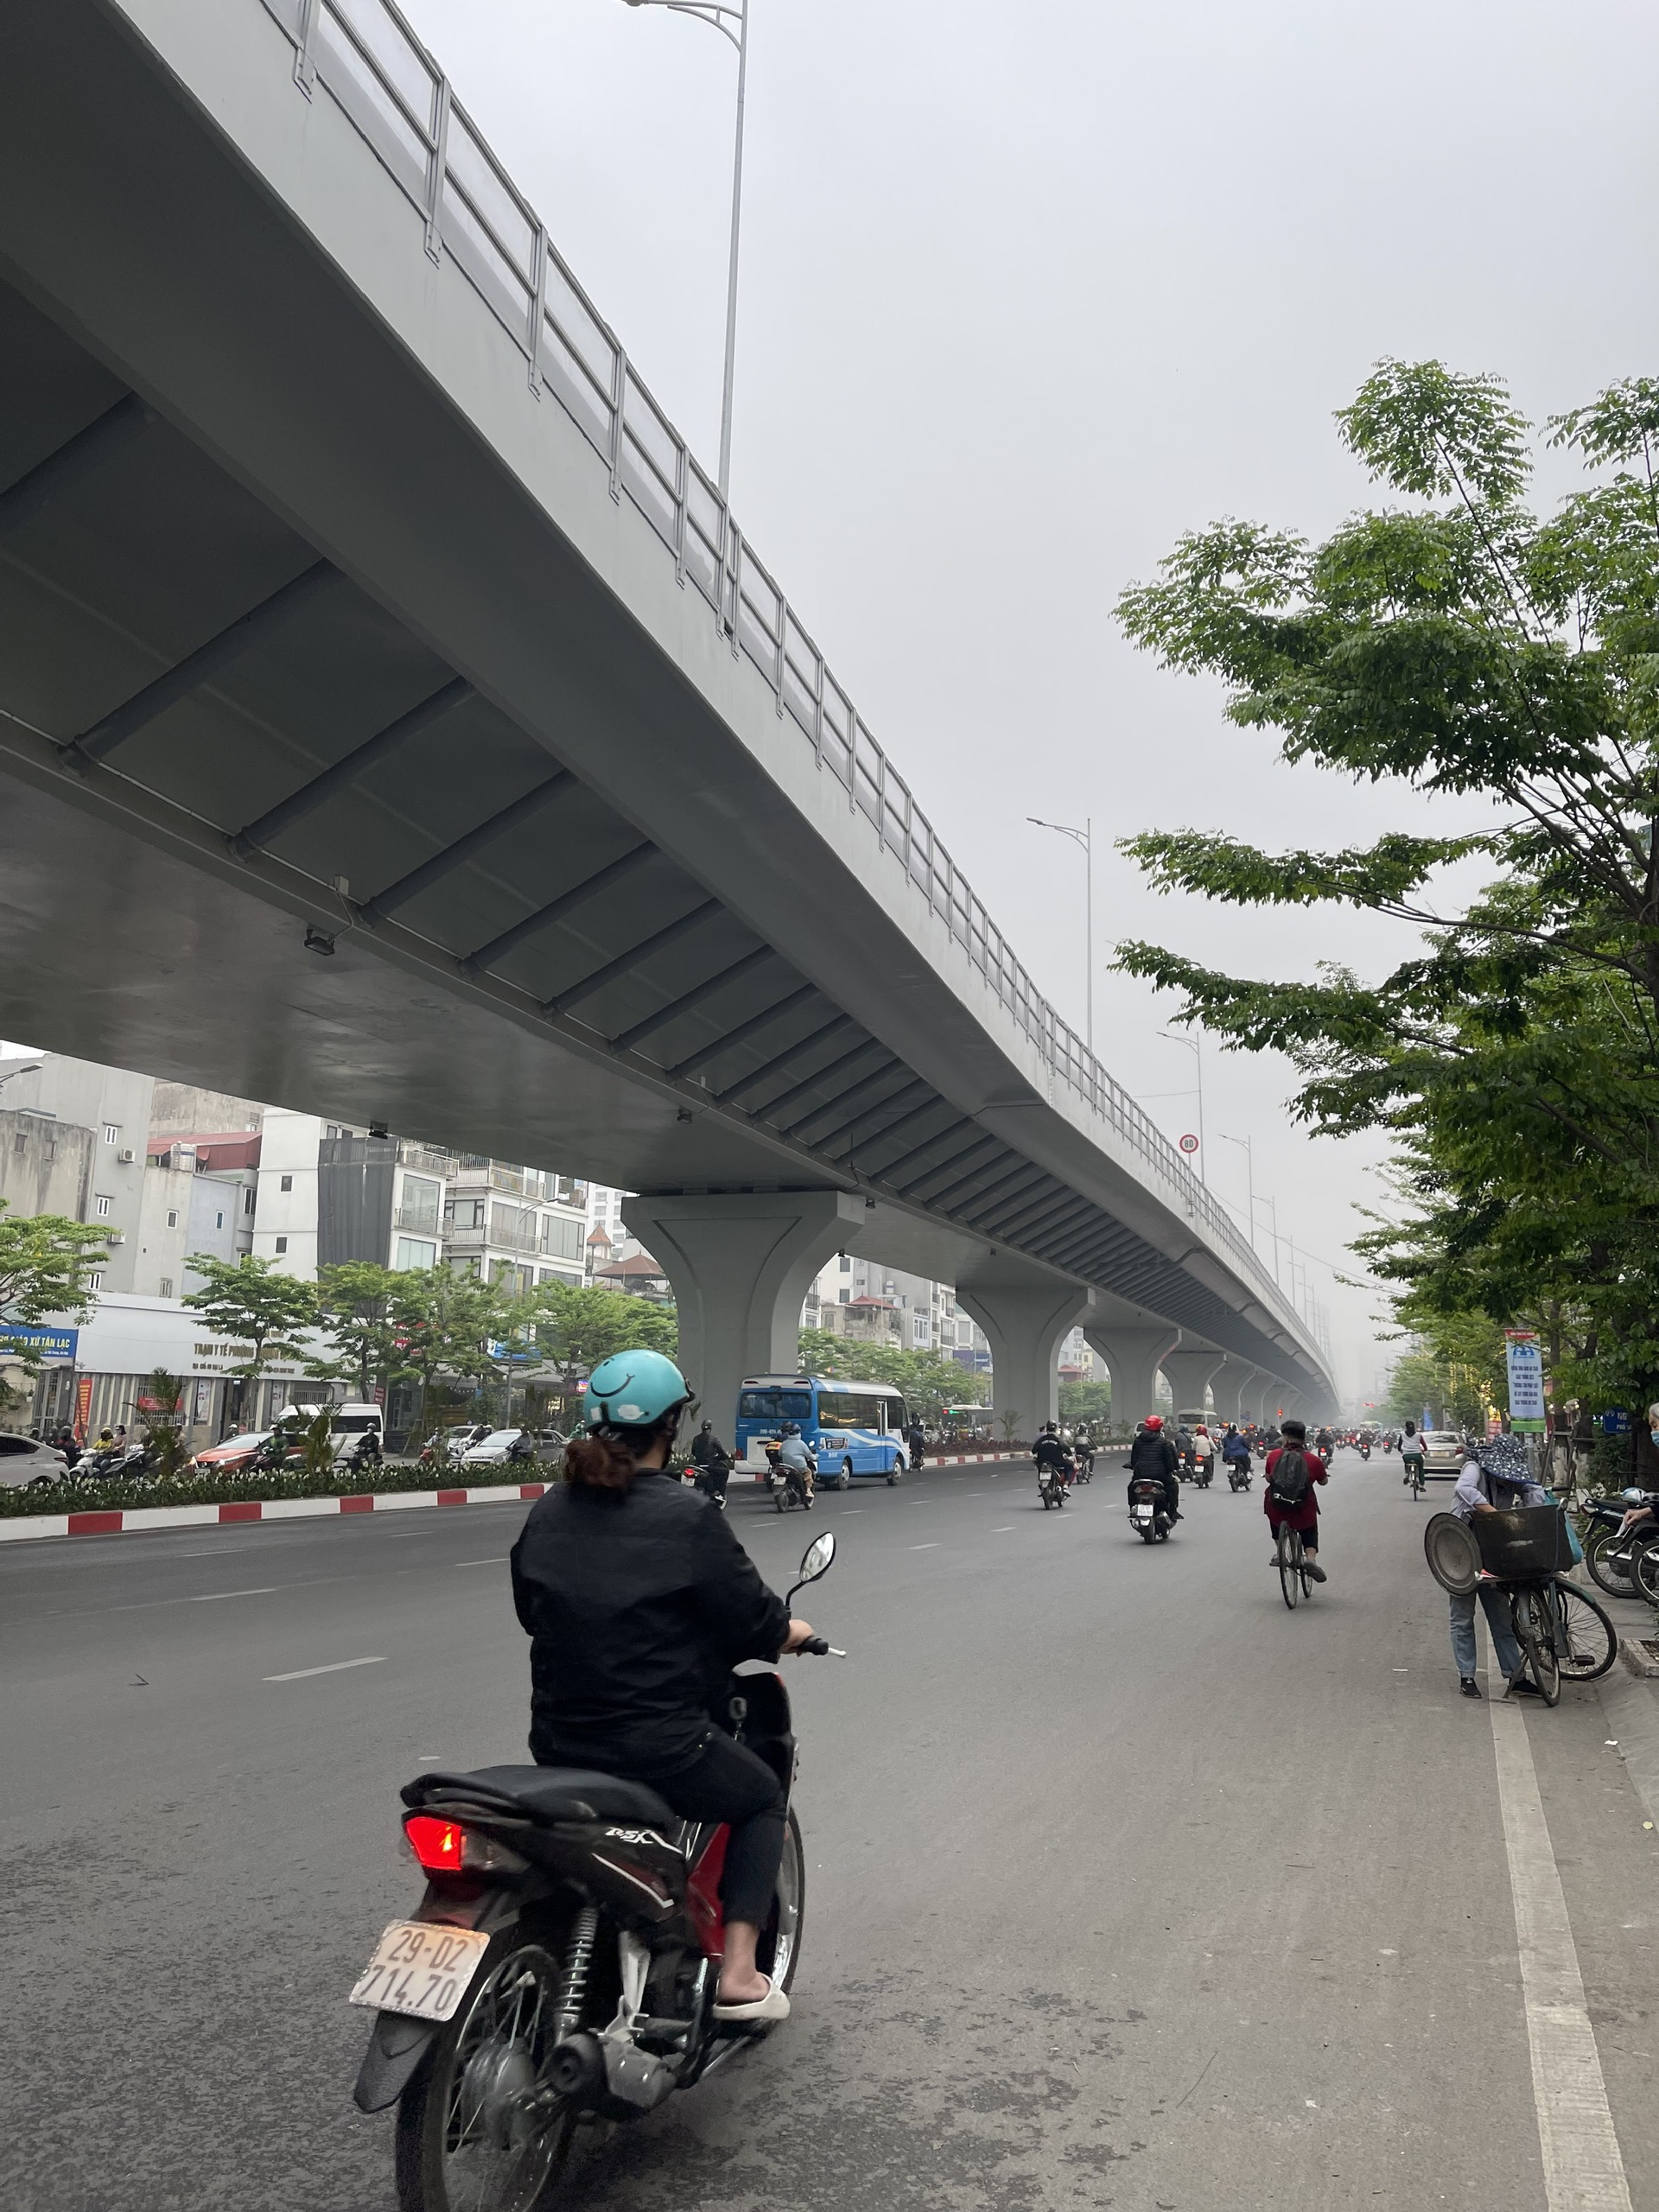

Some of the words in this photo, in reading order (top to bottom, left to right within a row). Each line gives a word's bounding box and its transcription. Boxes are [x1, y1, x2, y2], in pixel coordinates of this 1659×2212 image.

[1184, 1139, 1193, 1148] 80
[29, 1335, 41, 1347] XỨ
[41, 1336, 55, 1348] TÂN
[56, 1338, 71, 1350] LẠC
[214, 1344, 219, 1356] Y
[388, 1929, 468, 1972] 29-D2
[360, 1964, 458, 2012] 714.70
